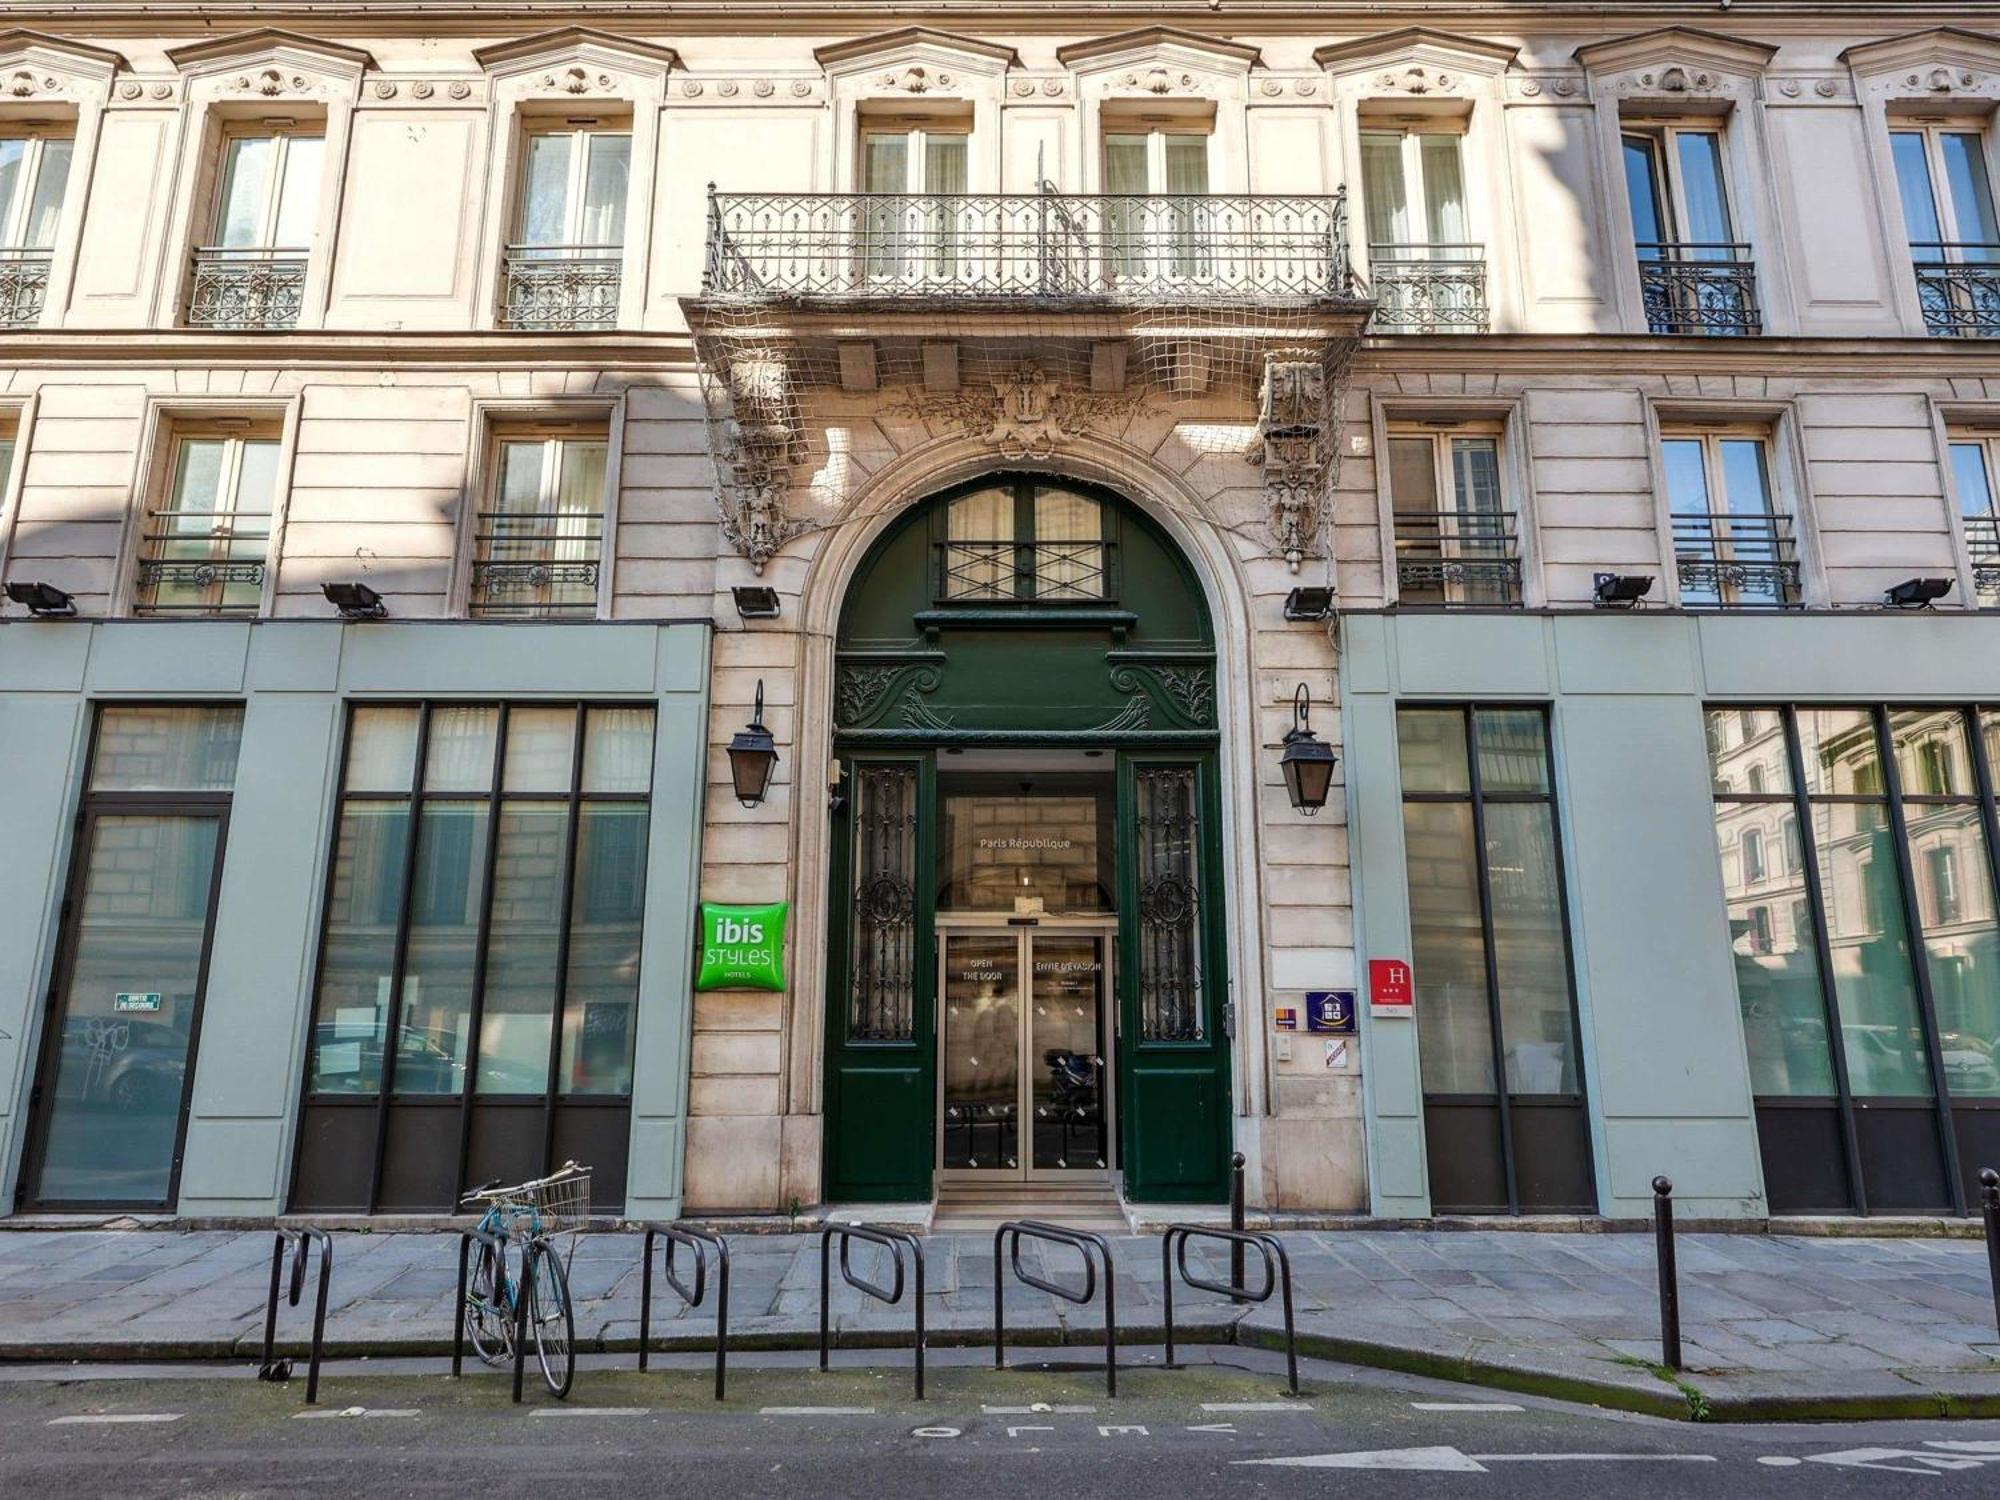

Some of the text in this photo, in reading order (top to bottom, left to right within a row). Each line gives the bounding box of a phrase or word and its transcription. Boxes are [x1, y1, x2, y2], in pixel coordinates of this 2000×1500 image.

[980, 838, 1071, 850] Paris République
[716, 918, 764, 944] ibis
[970, 960, 993, 968] OPEN
[962, 972, 1002, 981] THE DOOR
[1389, 967, 1405, 984] H
